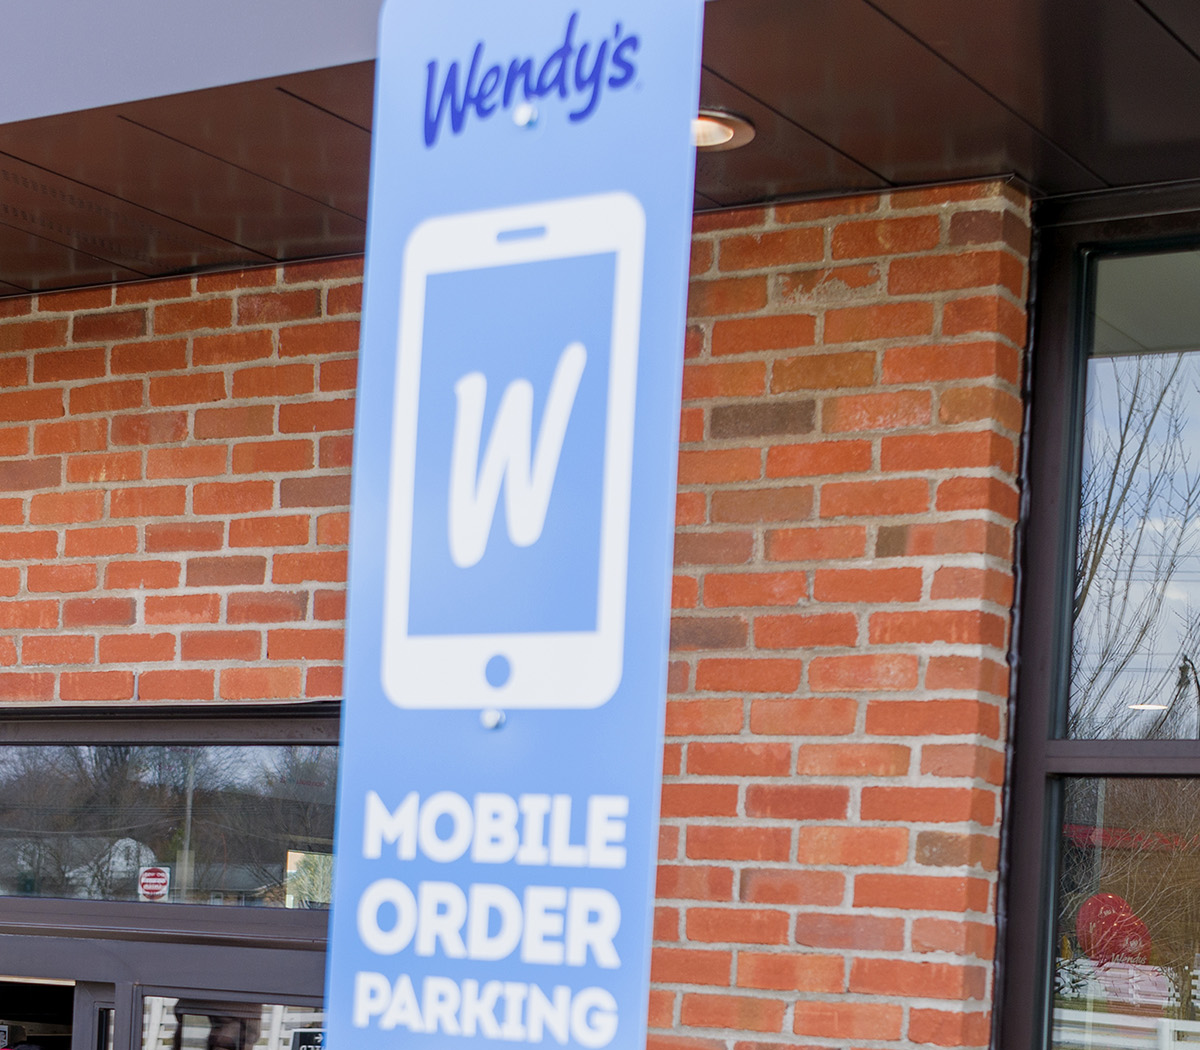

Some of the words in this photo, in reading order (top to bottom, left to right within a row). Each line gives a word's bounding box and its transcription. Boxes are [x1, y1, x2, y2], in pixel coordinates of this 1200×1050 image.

[424, 11, 638, 147] Wendy's
[449, 341, 588, 568] W
[363, 790, 629, 869] MOBILE
[356, 878, 621, 970] ORDER
[353, 971, 619, 1049] PARKING
